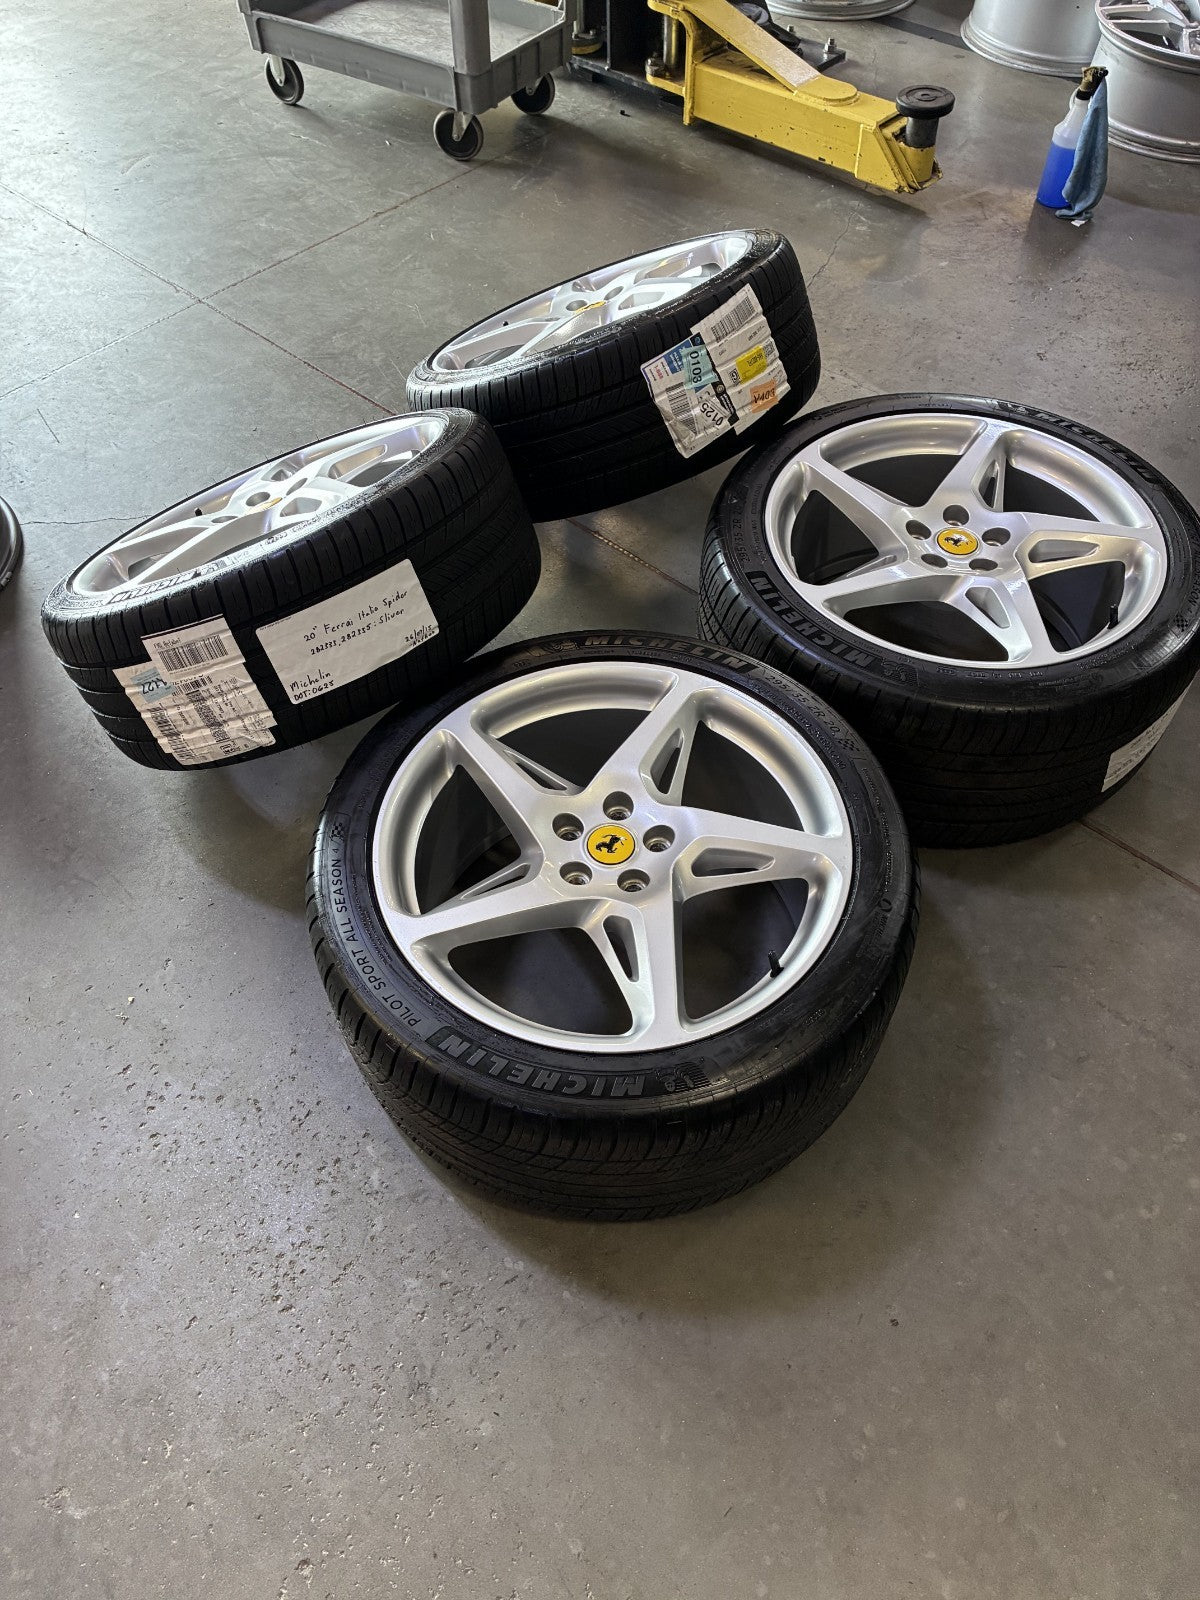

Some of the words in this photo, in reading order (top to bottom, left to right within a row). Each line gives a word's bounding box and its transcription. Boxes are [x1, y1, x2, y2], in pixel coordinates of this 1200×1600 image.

[689, 350, 702, 384] 0103
[700, 402, 724, 427] 0125
[1035, 412, 1158, 482] MICHELIN
[383, 590, 408, 609] Spider
[750, 577, 875, 668] MICHELIN
[584, 635, 747, 669] MICHELIN
[290, 668, 331, 692] Michelin
[331, 858, 348, 913] SEASON
[340, 916, 359, 942] ALL
[351, 949, 387, 991] SPORT
[381, 993, 422, 1028] PILOT
[438, 1032, 647, 1097] MICHELIN
